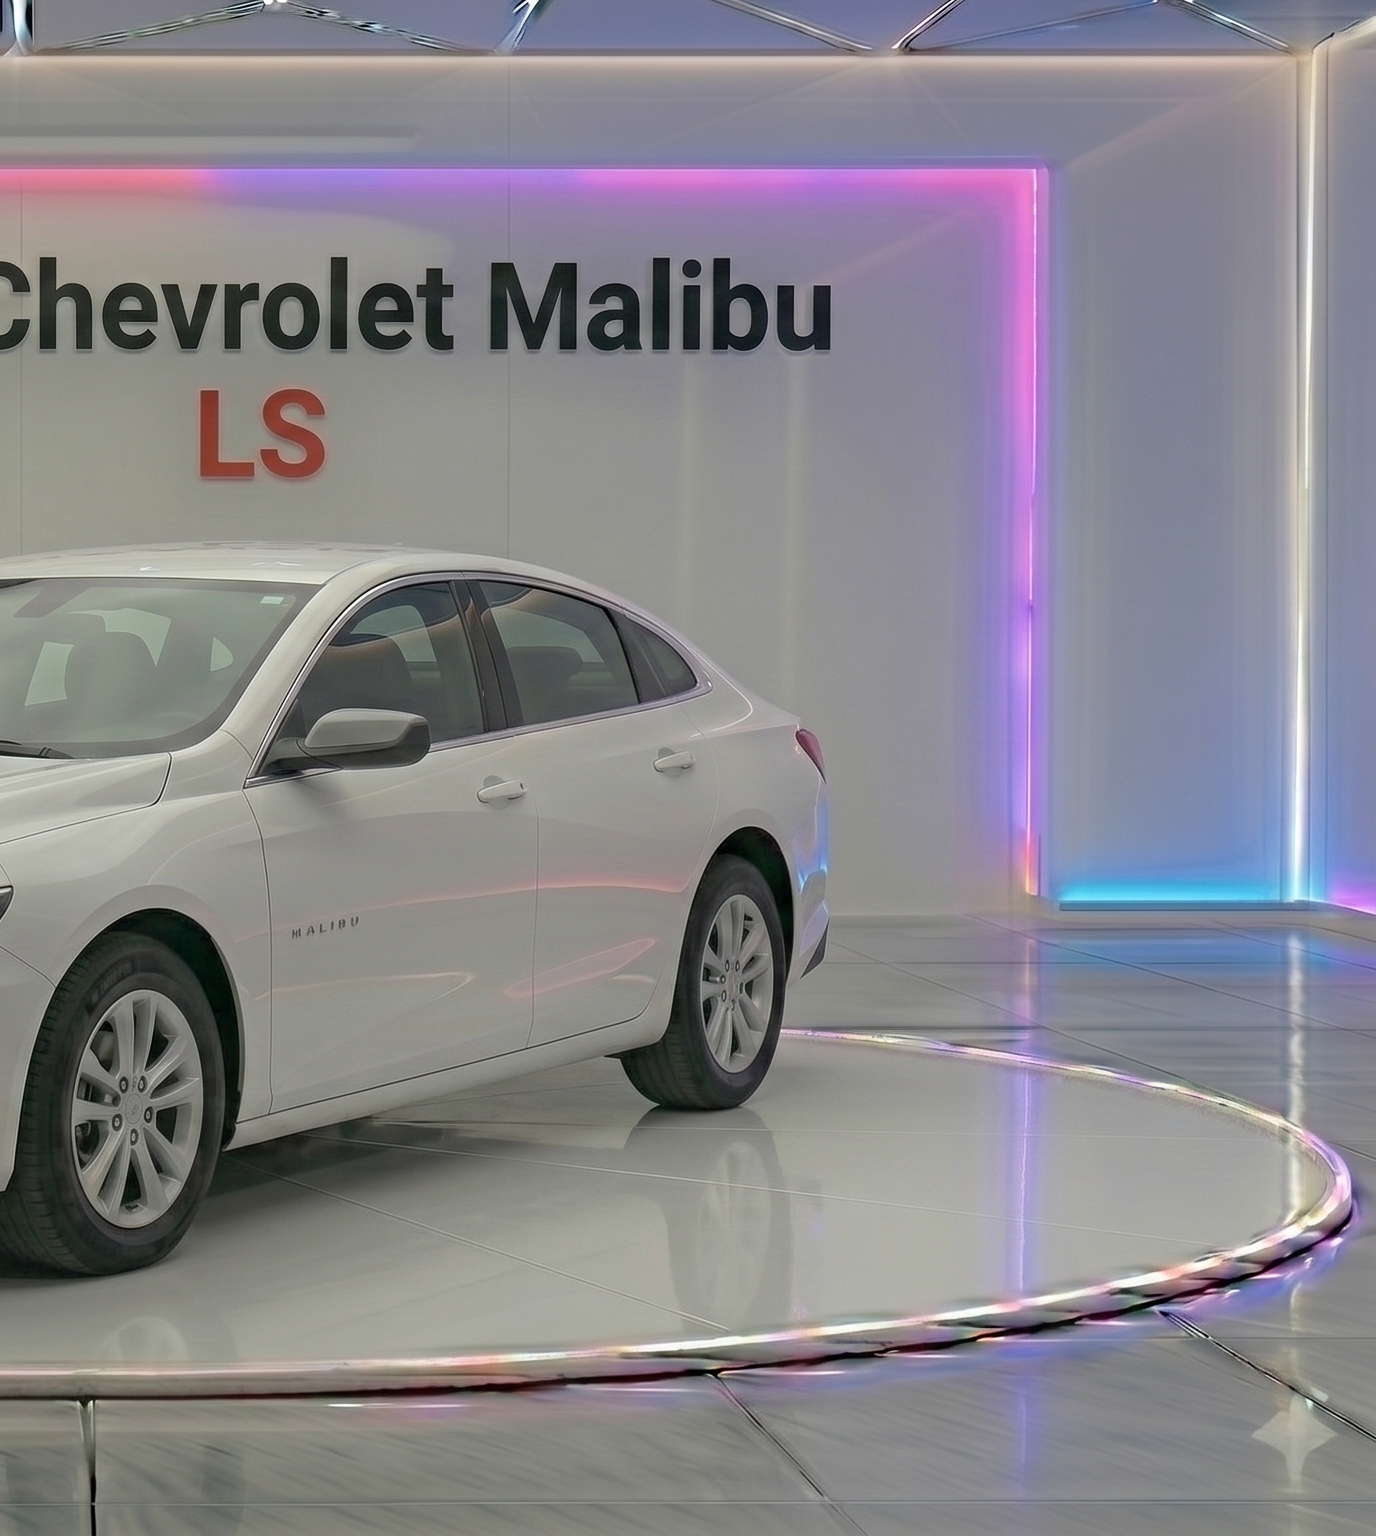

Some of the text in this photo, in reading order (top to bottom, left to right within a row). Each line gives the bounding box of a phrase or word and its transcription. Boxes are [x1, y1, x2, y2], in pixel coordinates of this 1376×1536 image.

[489, 257, 832, 351] Malibu
[199, 388, 326, 478] LS
[291, 916, 360, 939] MALIBU
